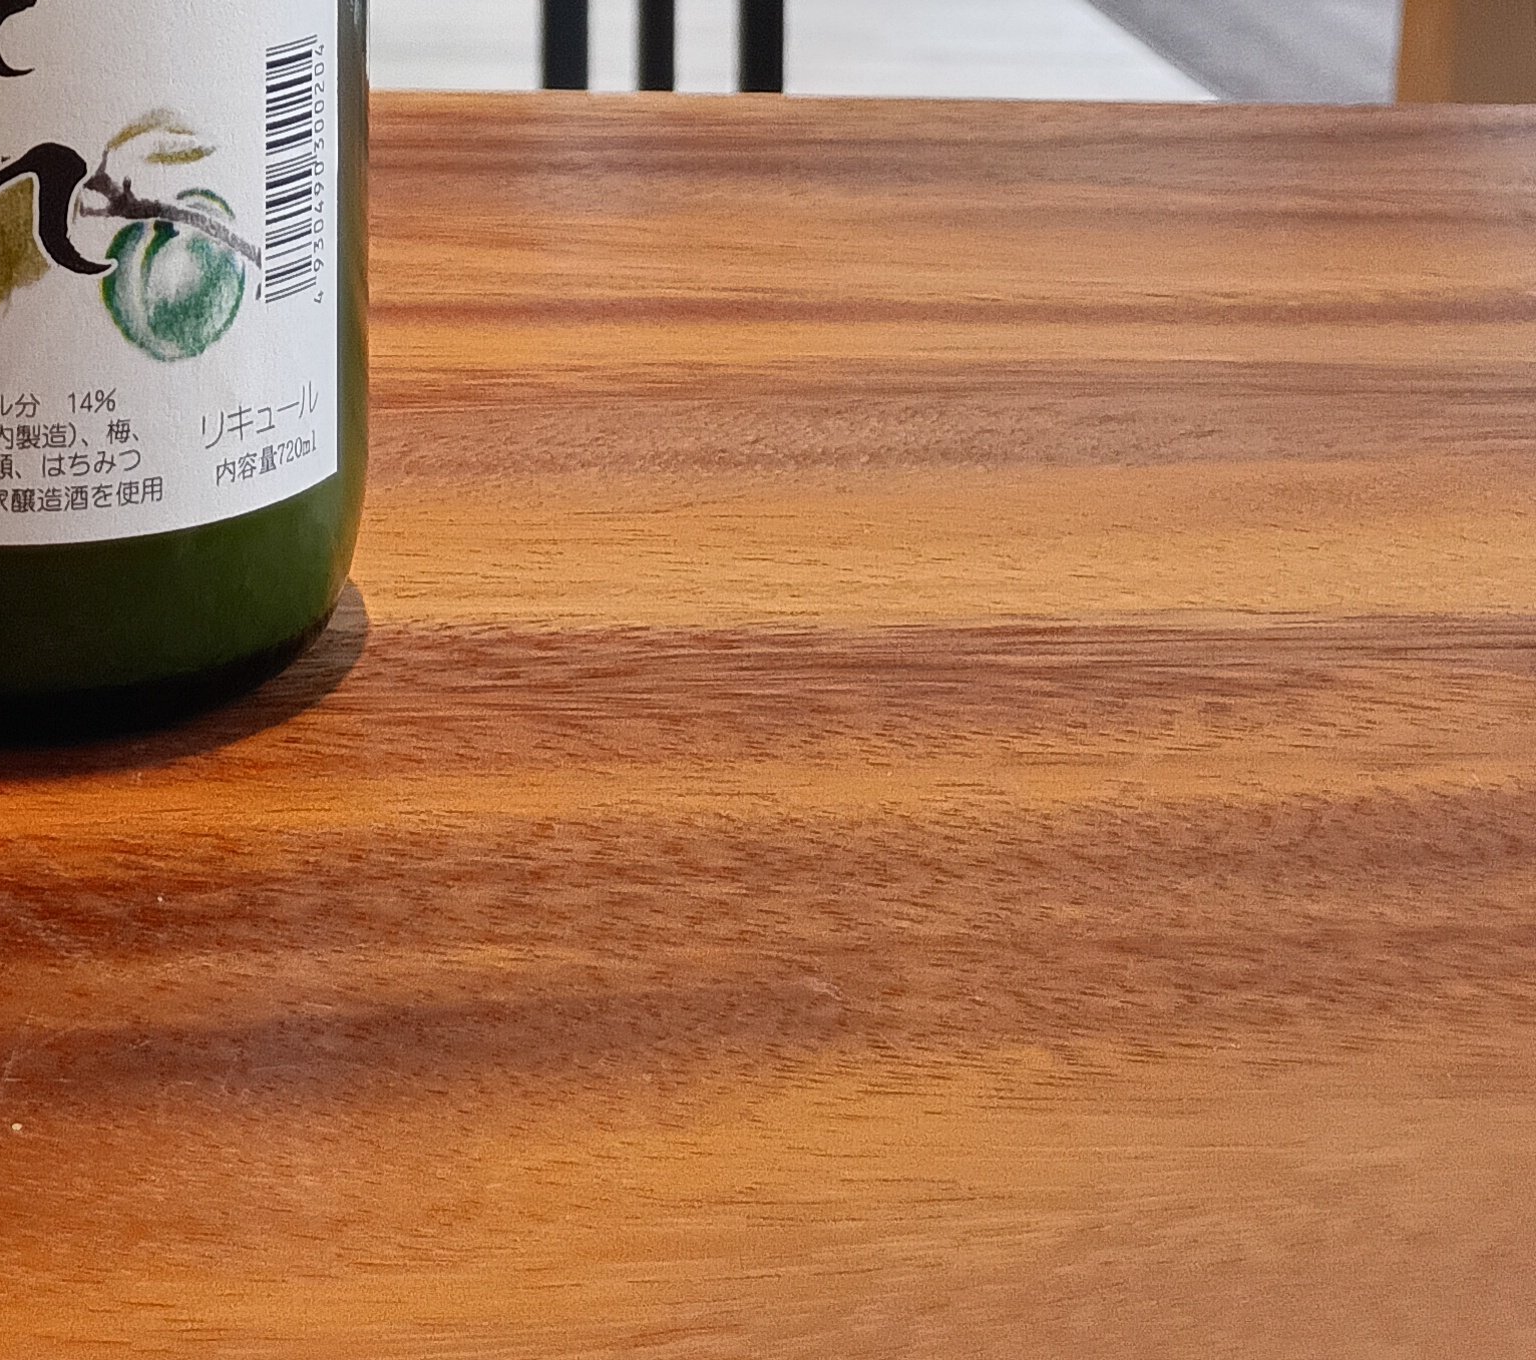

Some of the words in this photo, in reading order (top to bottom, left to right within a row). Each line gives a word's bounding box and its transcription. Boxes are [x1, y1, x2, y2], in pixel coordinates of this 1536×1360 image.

[67, 388, 117, 415] 14%
[202, 381, 319, 450] リキュール
